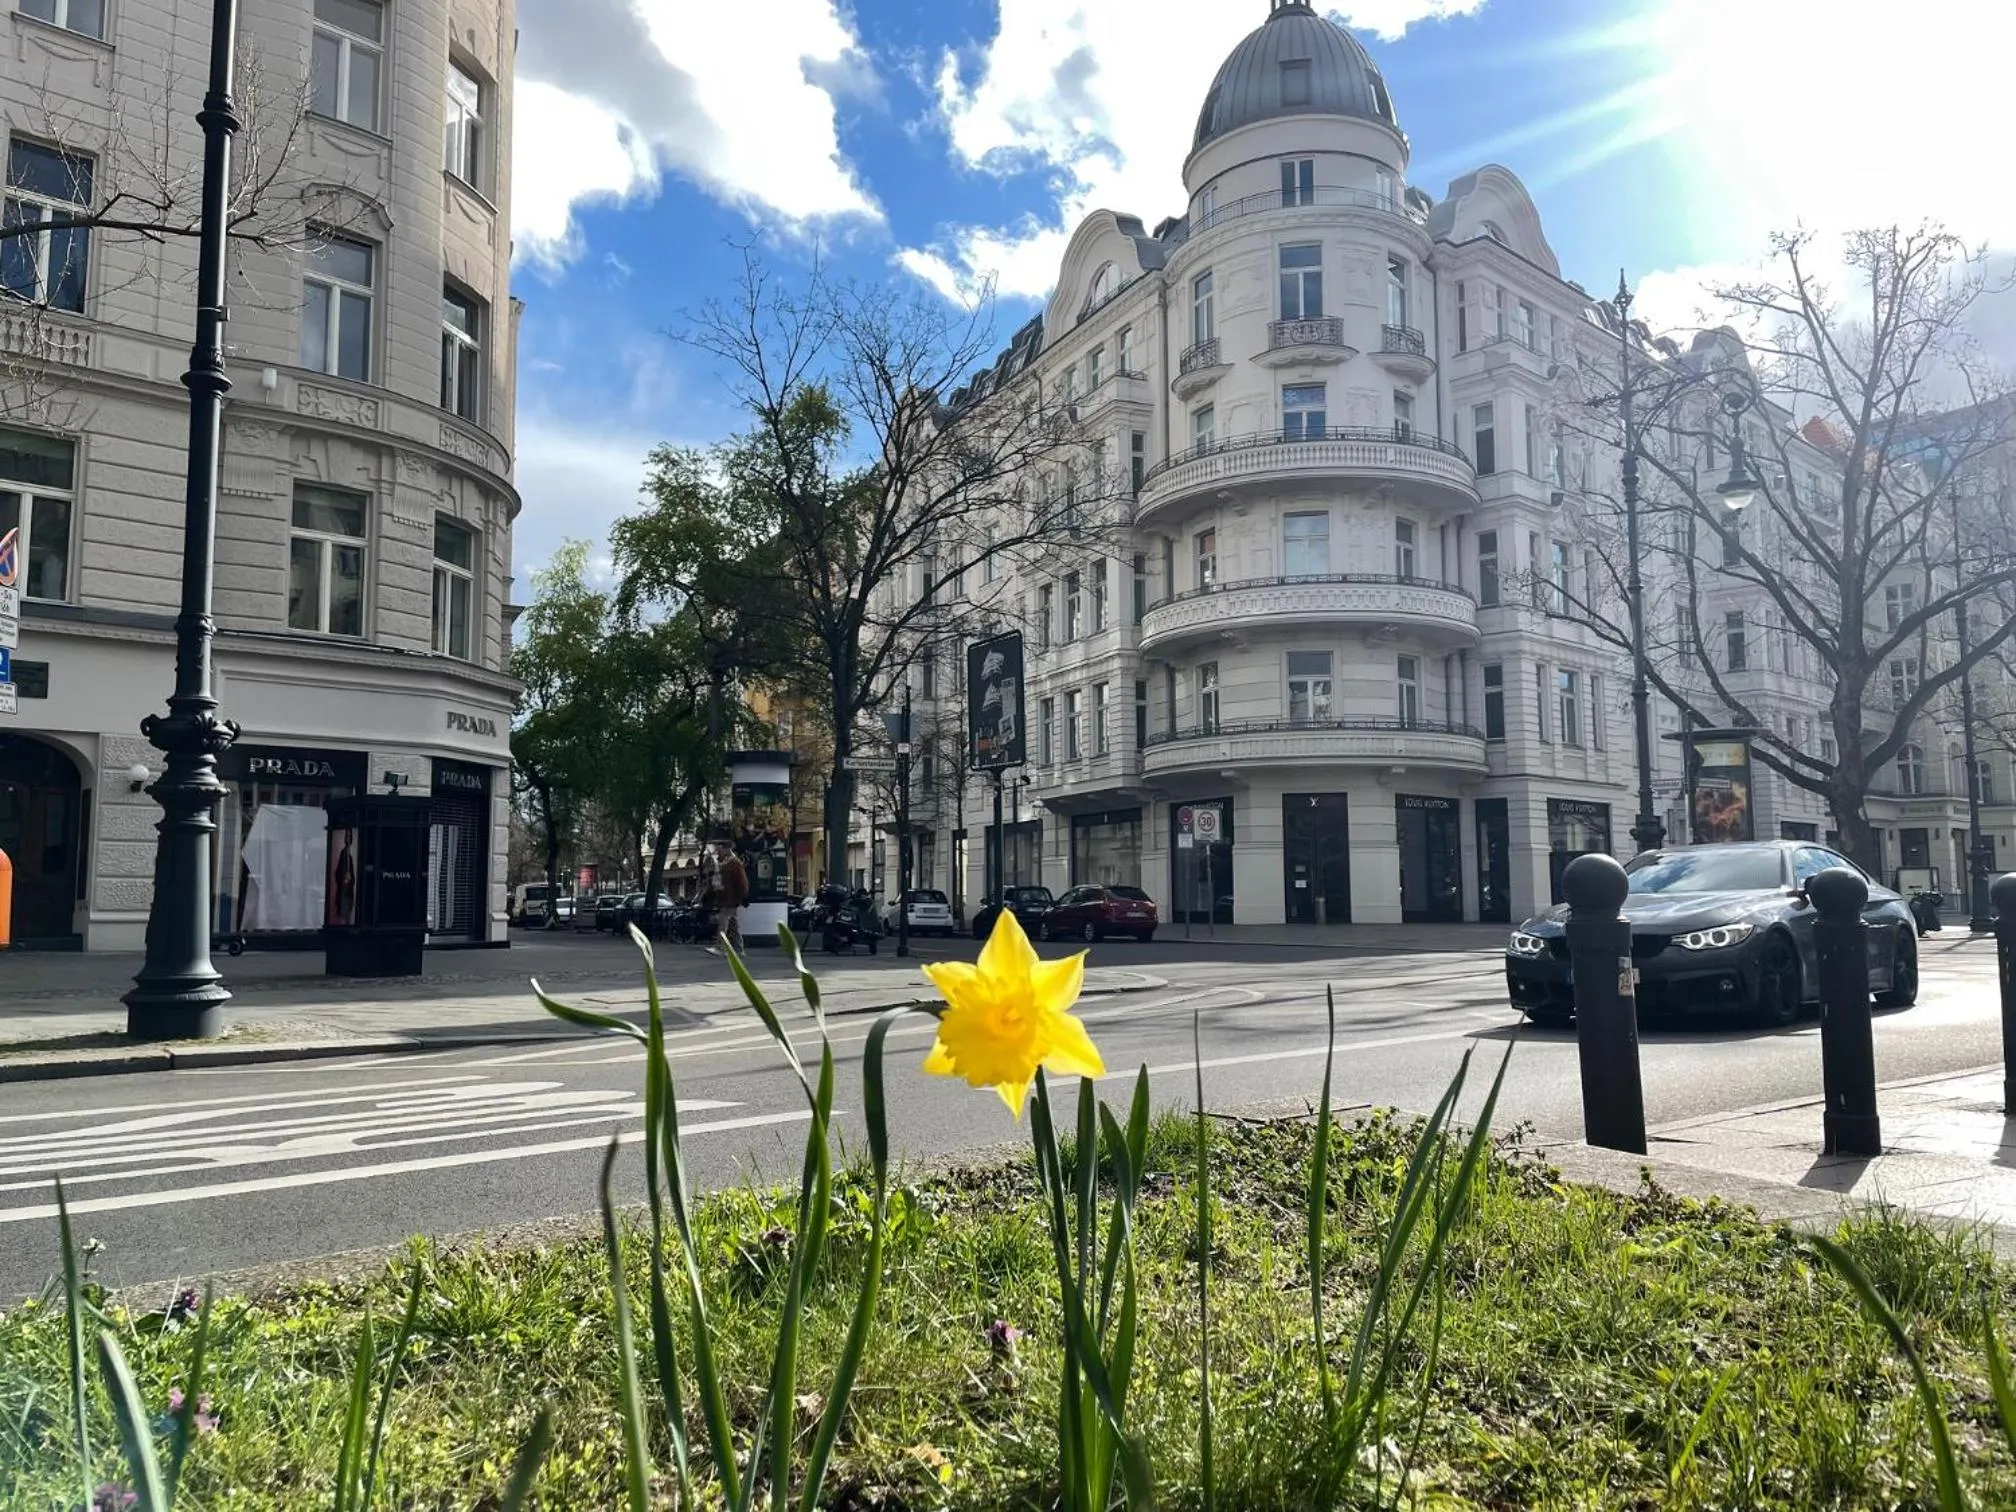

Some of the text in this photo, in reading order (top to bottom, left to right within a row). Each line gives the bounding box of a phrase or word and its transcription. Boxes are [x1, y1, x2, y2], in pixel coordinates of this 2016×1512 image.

[446, 711, 497, 737] PRADA
[249, 757, 335, 777] PRADA
[442, 771, 482, 789] PRADA
[1200, 816, 1212, 828] 30
[382, 871, 412, 879] PRADA
